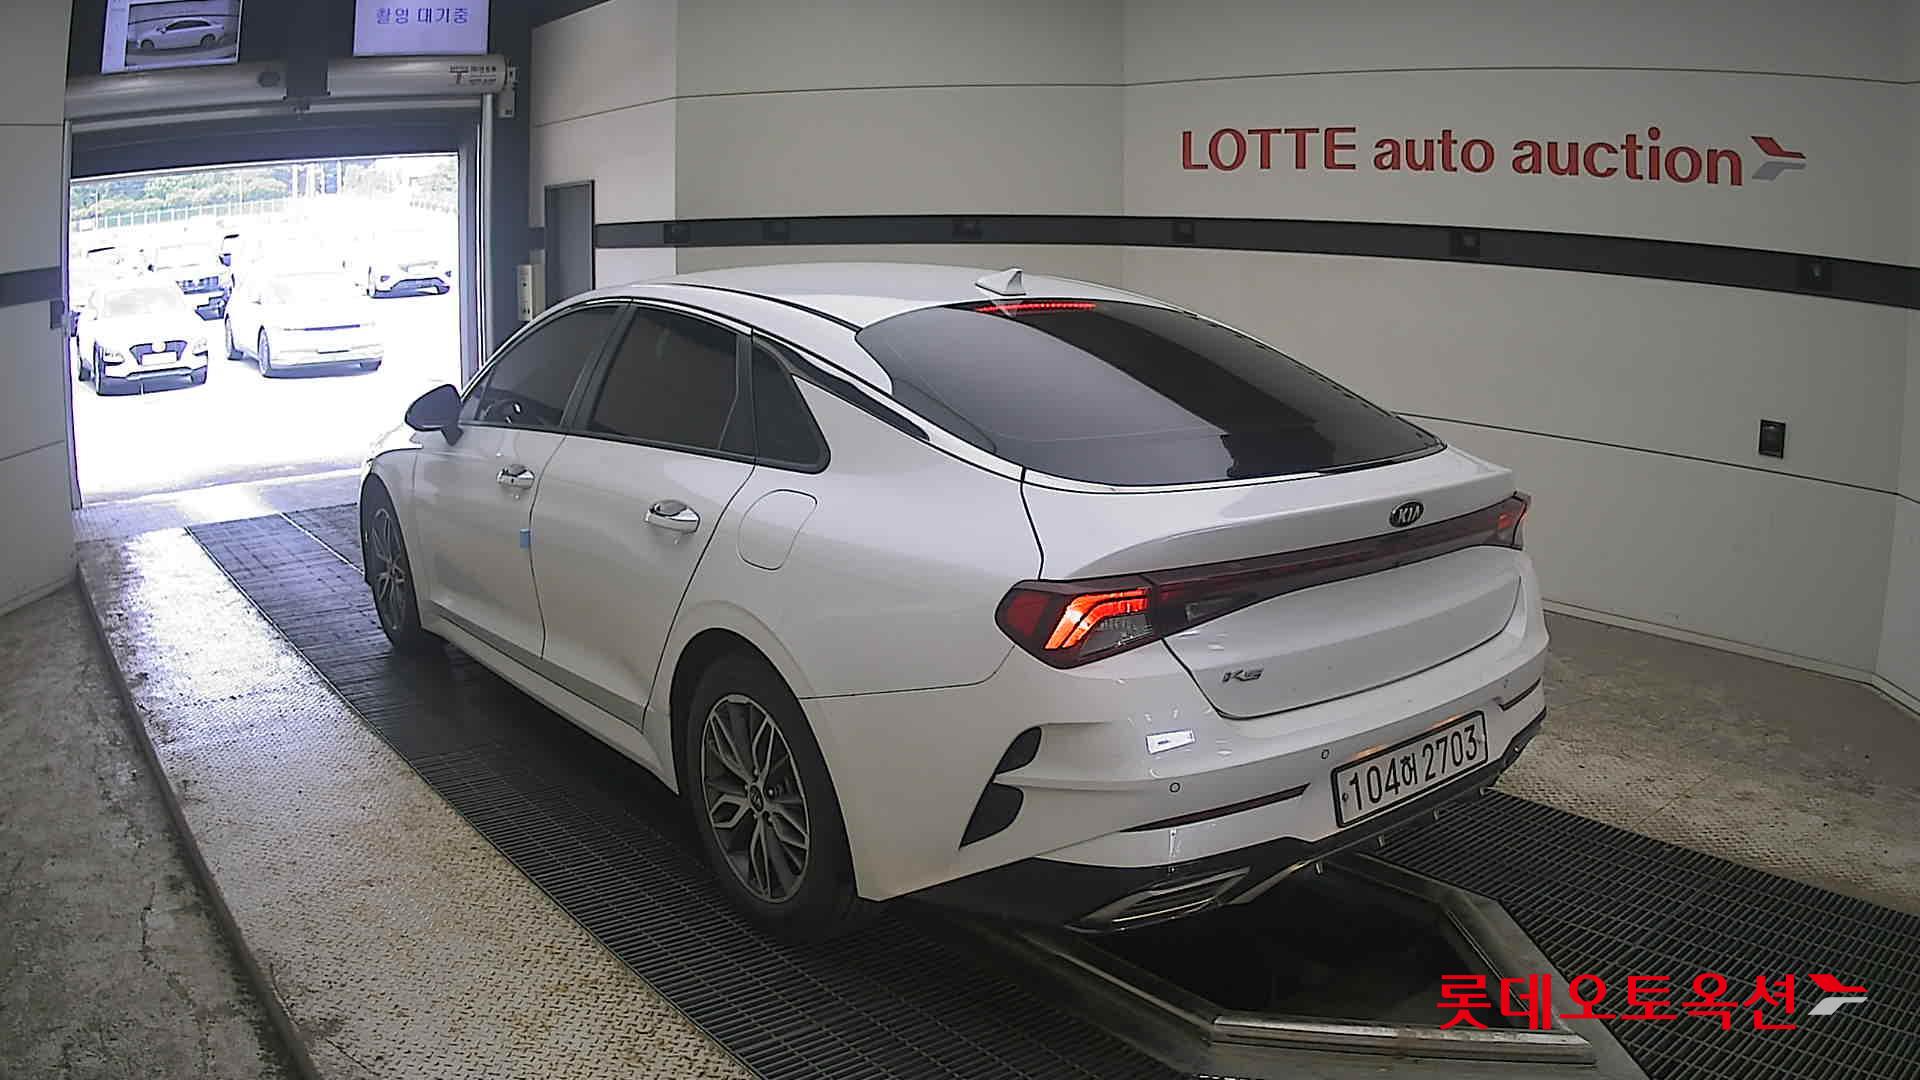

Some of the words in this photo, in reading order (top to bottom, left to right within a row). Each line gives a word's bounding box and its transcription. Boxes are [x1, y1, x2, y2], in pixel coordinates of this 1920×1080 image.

[417, 8, 469, 24] 대기중
[1182, 127, 1357, 171] LOTTE
[1373, 129, 1495, 173] auto
[1511, 126, 1743, 186] auction
[1421, 724, 1478, 782] 2703
